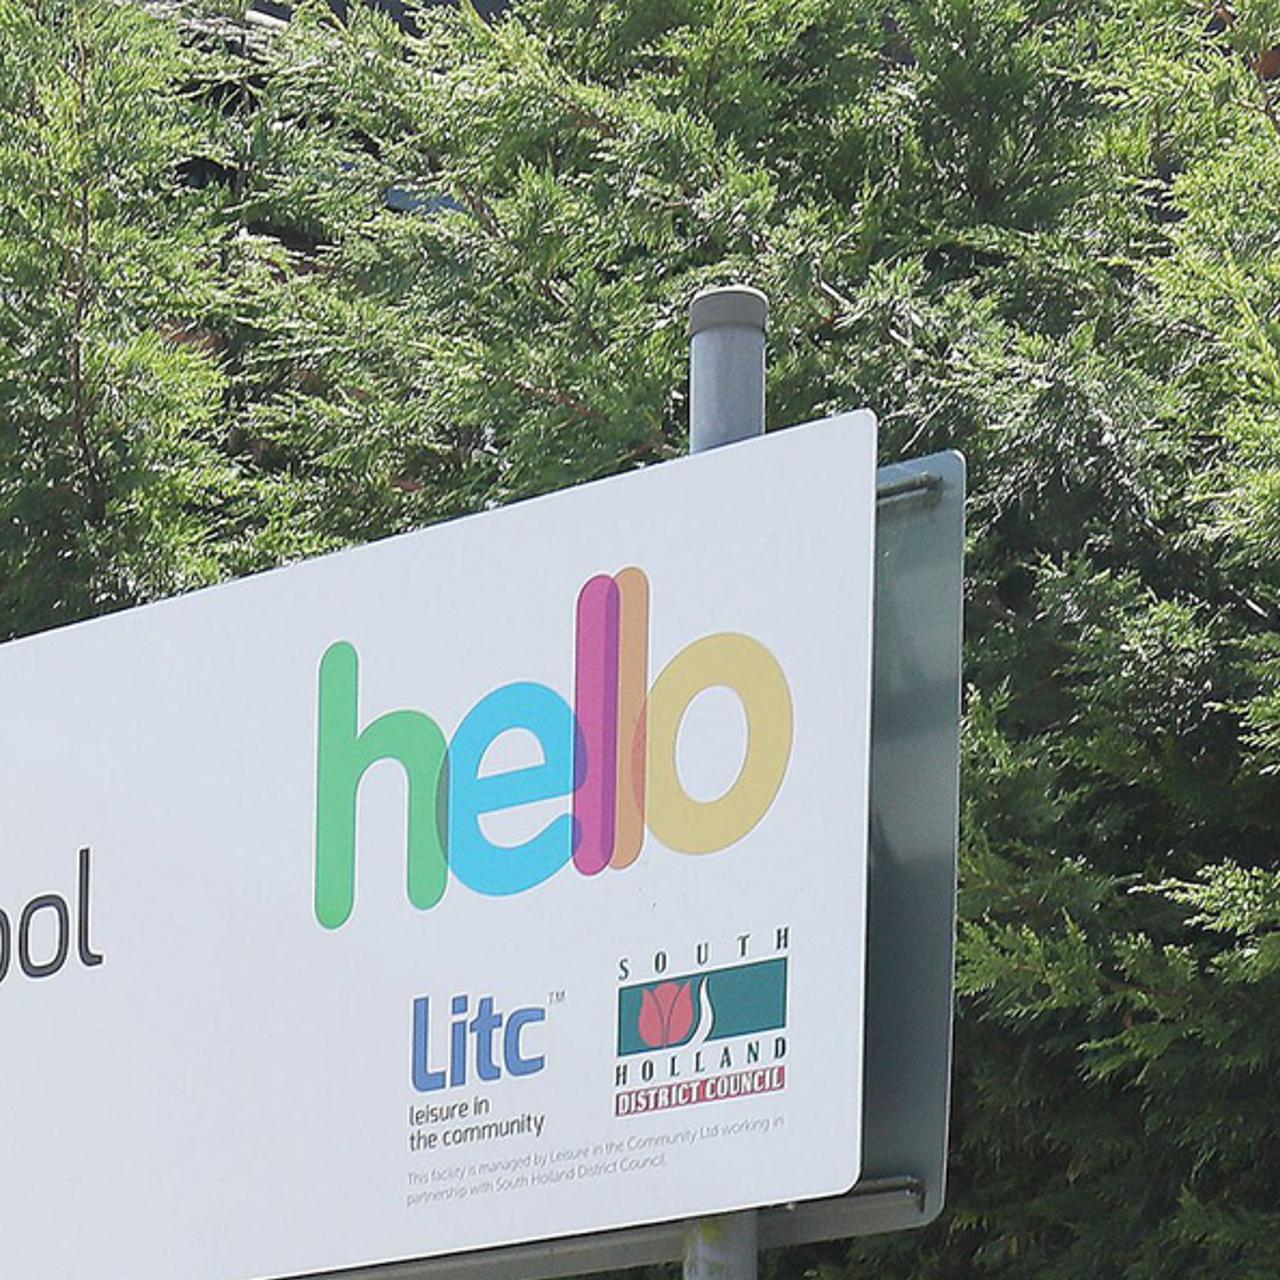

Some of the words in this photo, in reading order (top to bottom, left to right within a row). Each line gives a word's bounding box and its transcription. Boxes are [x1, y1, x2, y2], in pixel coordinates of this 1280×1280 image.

[314, 566, 793, 930] hello
[412, 994, 546, 1092] Litc
[615, 1036, 787, 1087] HOLLAND
[408, 1100, 469, 1127] leisure
[473, 1096, 490, 1115] in
[617, 1080, 701, 1115] DISTRICT
[706, 1066, 783, 1100] COUNCIL
[409, 1129, 439, 1152] the
[442, 1113, 546, 1147] community
[627, 1125, 697, 1152] Community
[494, 1168, 530, 1194] South
[532, 1157, 577, 1186] Holland
